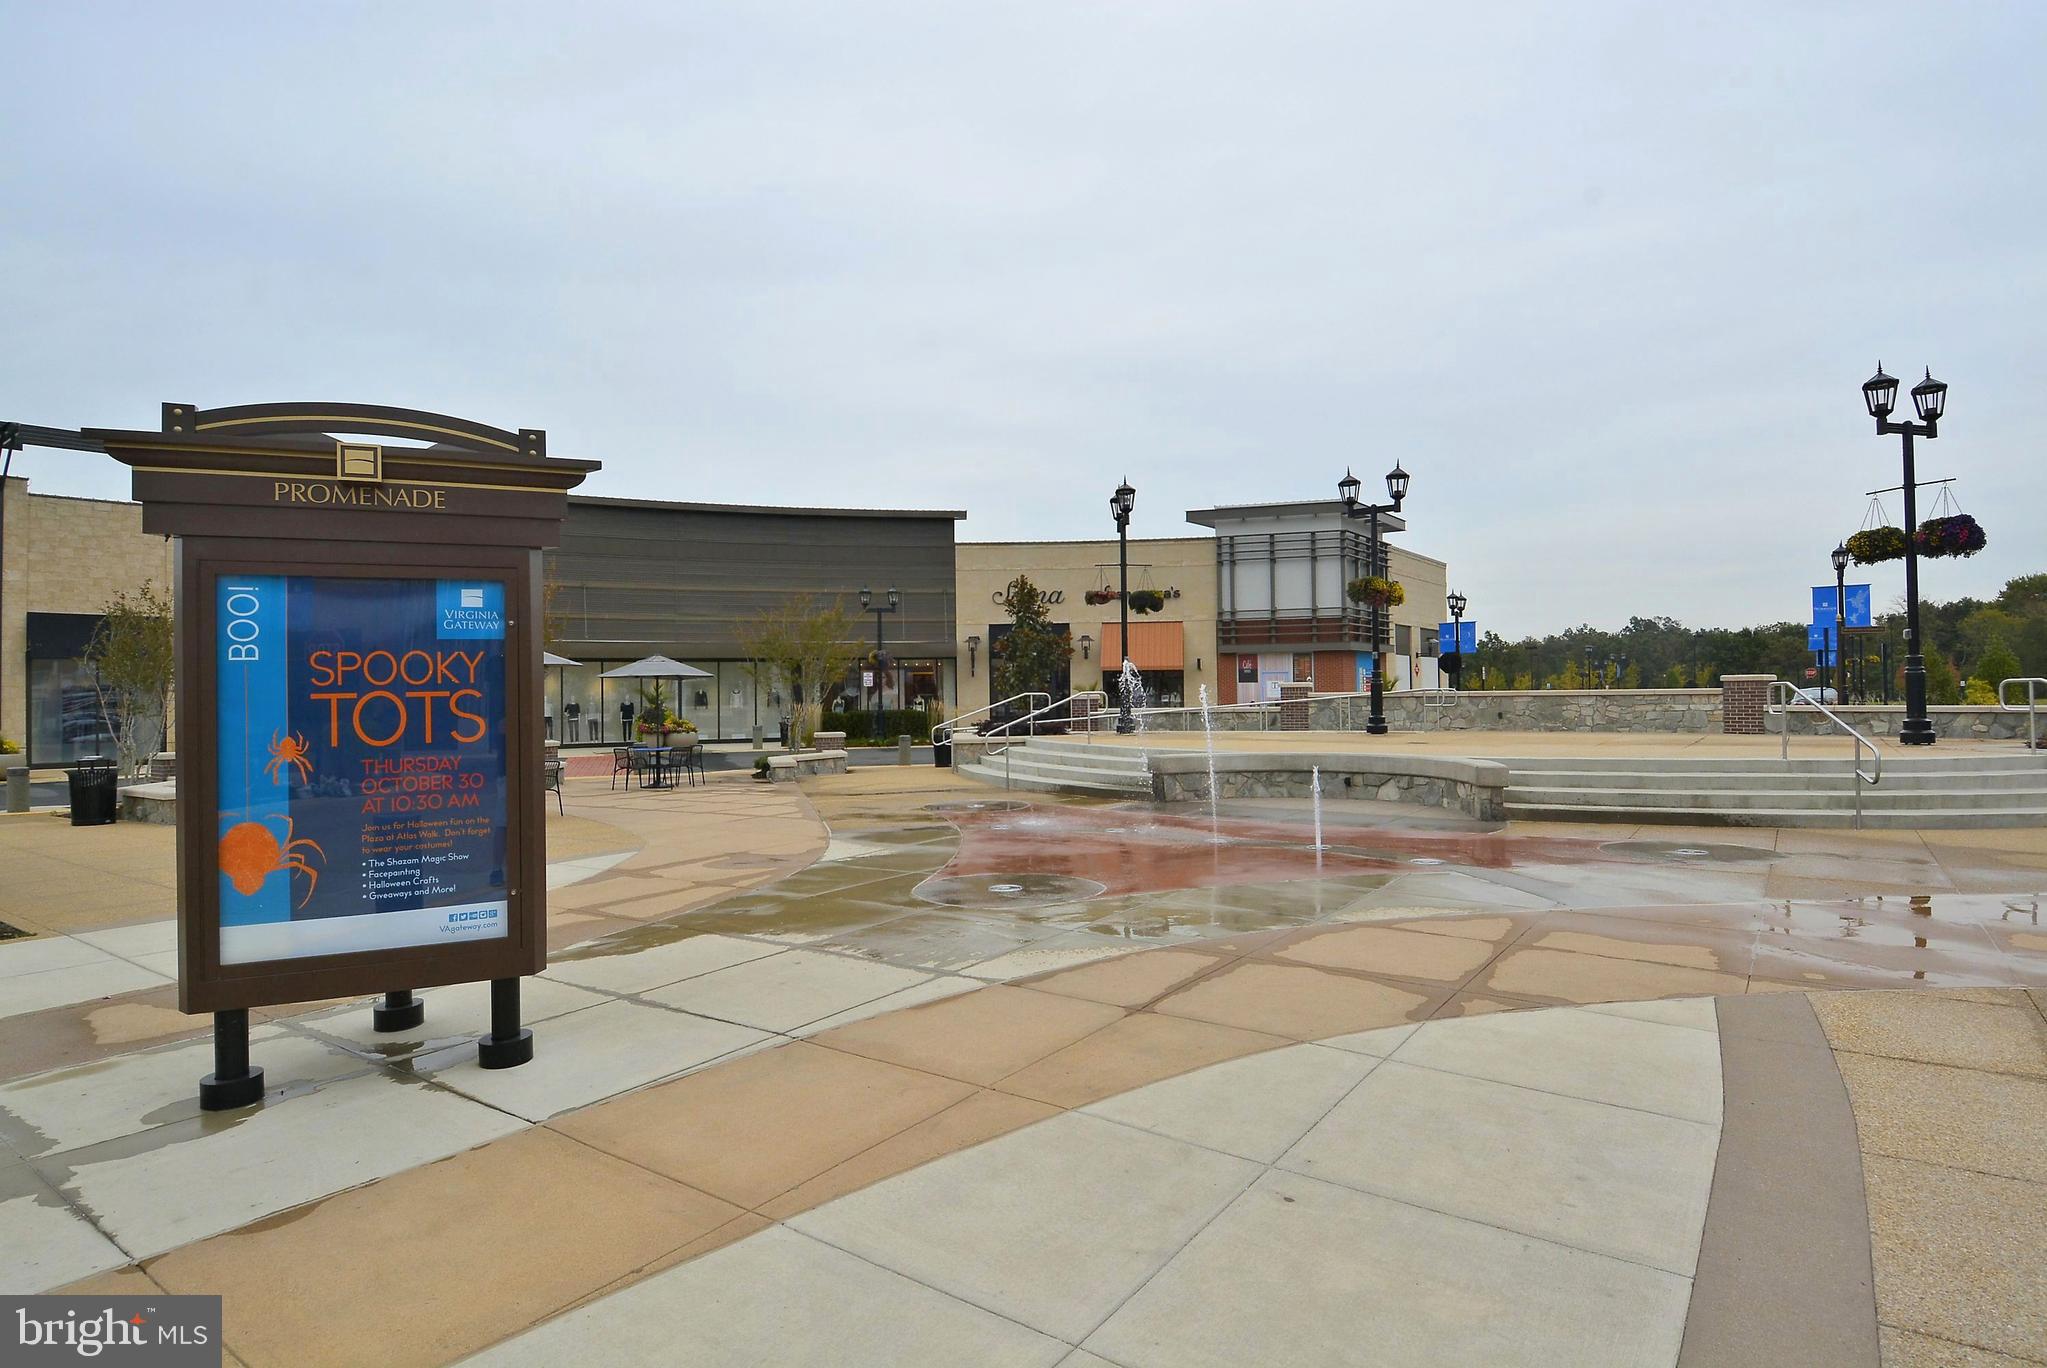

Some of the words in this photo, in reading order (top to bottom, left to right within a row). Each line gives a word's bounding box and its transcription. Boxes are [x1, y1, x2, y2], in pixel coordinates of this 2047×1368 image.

[274, 482, 446, 509] PROMENADE
[444, 608, 499, 620] VIRGINIA
[226, 586, 260, 661] BOO!
[443, 619, 500, 630] GATEWAY
[309, 649, 485, 687] SPOOKY
[309, 688, 488, 748] TOTS
[361, 755, 462, 775] THURSDAY
[361, 774, 454, 795] OCTOBER
[458, 772, 485, 790] 30
[361, 797, 385, 814] AT
[391, 794, 443, 813] 10:30
[447, 793, 480, 808] AM
[361, 823, 380, 832] Join
[393, 821, 406, 830] for
[407, 818, 449, 828] Halloween
[450, 817, 463, 825] fun
[465, 817, 476, 825] on
[477, 816, 490, 824] the
[361, 834, 385, 842] Plaza
[396, 832, 417, 841] Atlas
[444, 827, 466, 837] Don't
[467, 827, 491, 837] forget
[361, 846, 371, 854] to
[394, 844, 413, 855] your
[414, 840, 453, 850] costumes!
[368, 859, 385, 867] The
[386, 857, 420, 867] Shazam
[421, 854, 447, 865] Magic
[448, 852, 470, 861] Show
[368, 868, 421, 879] Facepainting
[368, 880, 411, 889] Halloween
[412, 875, 440, 885] Crafts
[368, 890, 412, 900] Giveaways
[414, 887, 430, 896] and
[431, 884, 456, 894] More!
[439, 922, 498, 934] VAgateway.com
